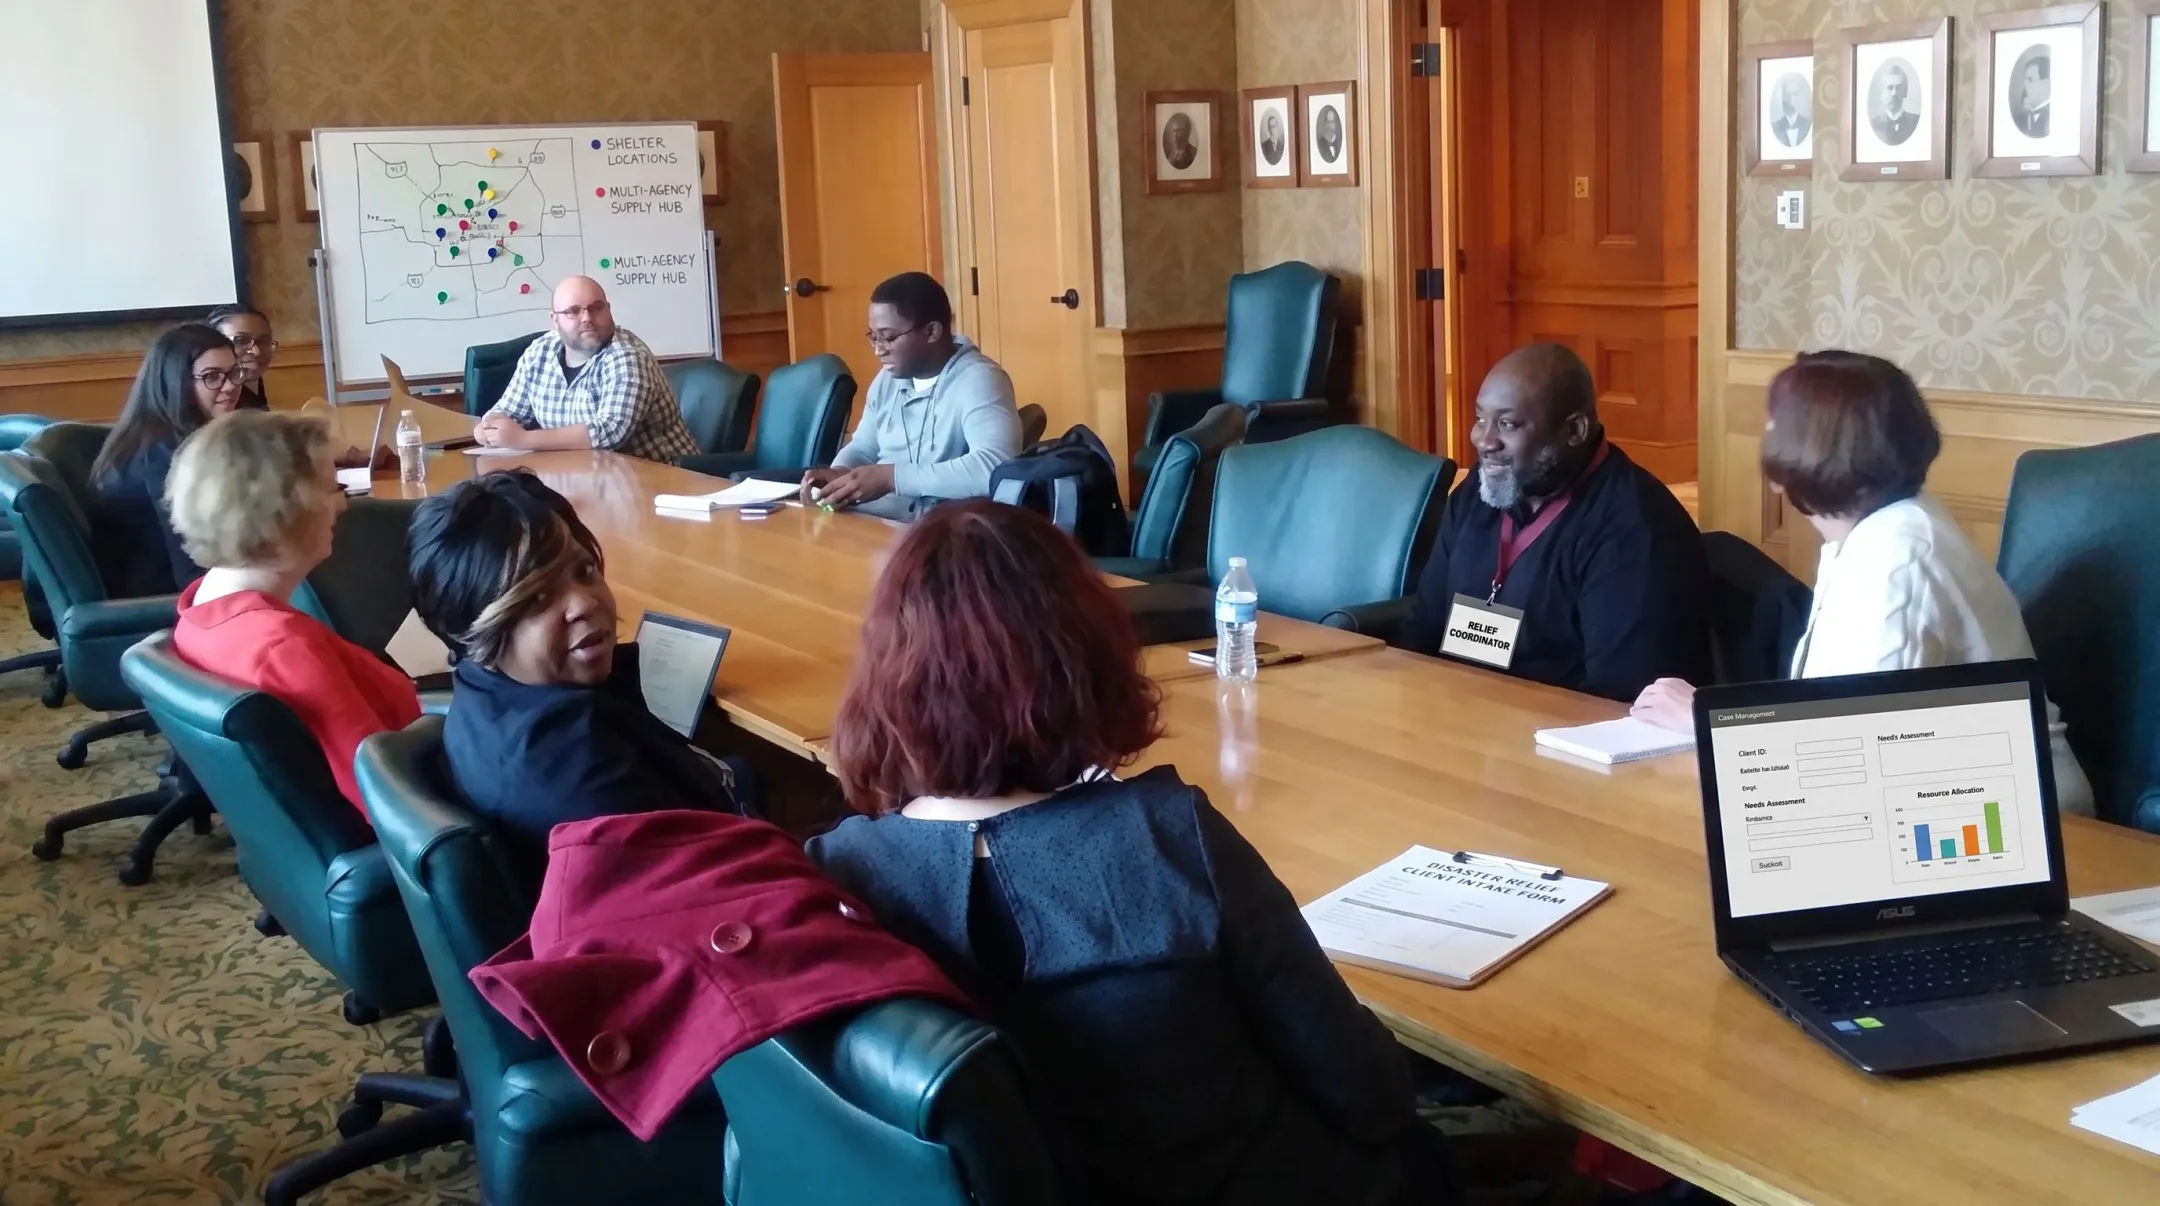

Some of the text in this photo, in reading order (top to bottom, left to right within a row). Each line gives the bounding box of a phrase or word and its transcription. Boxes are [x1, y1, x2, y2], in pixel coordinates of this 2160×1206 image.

[606, 137, 666, 150] SHELTER
[607, 152, 678, 166] LOCATIONS
[609, 184, 693, 198] MULTI-AGENCY
[611, 201, 683, 214] SUPPLY HUB
[614, 254, 695, 269] MULTI-AGENCY
[615, 271, 687, 286] SUPPLY HUB
[1468, 621, 1498, 635] RELIEF
[1449, 628, 1510, 650] COORDINATOR
[1877, 733, 1898, 742] Needs
[1738, 748, 1767, 757] Client ID:
[1917, 786, 1985, 799] Resource Allocation
[1744, 798, 1806, 809] Needs Assessment
[1427, 862, 1562, 893] DISASTER RELIEF
[1402, 866, 1567, 905] CLIENT INTAKE FORM
